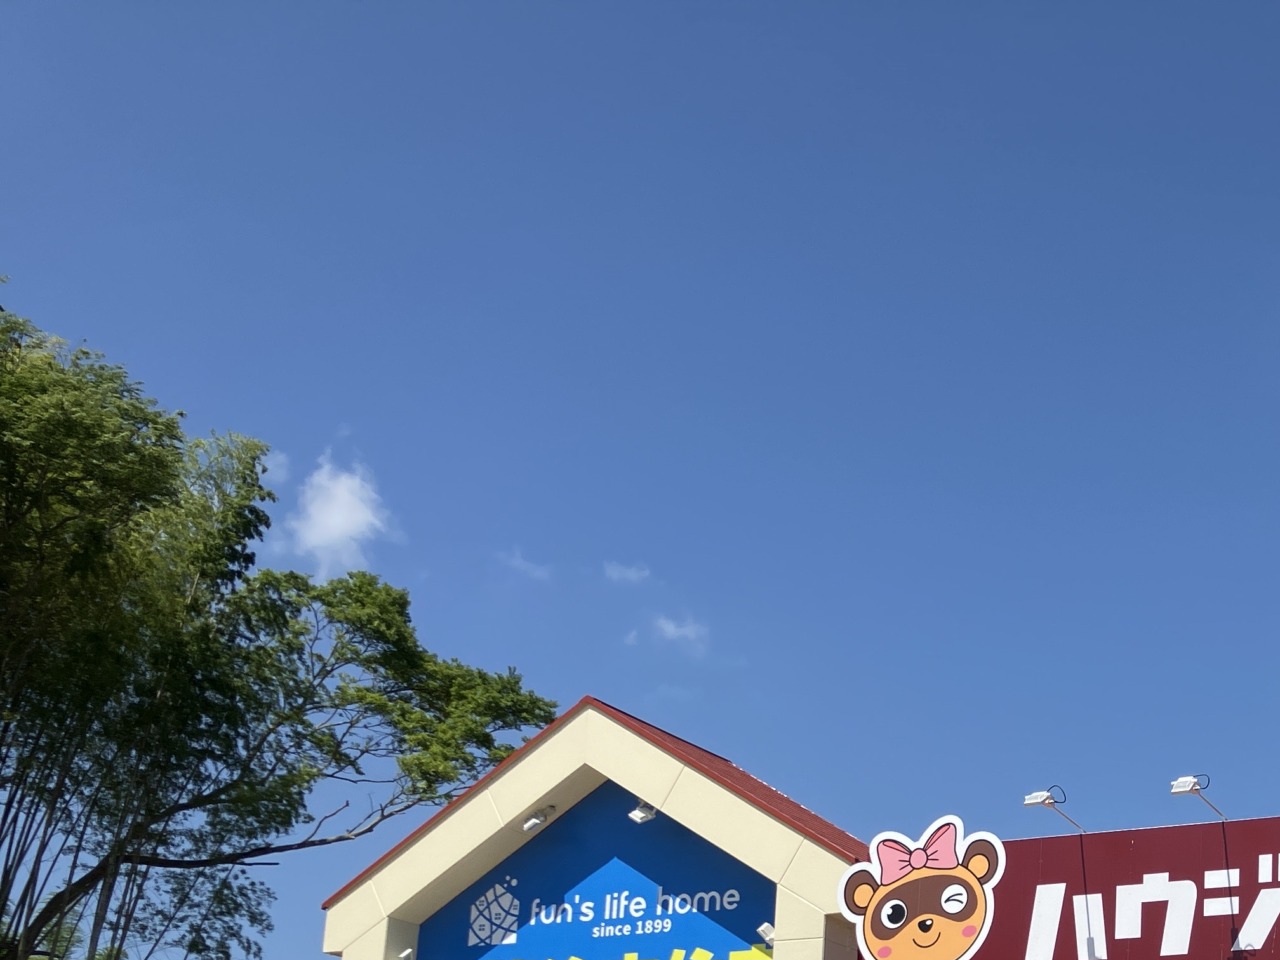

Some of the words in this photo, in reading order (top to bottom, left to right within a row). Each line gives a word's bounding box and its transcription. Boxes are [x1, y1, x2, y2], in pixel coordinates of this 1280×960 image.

[530, 895, 595, 925] fun's
[605, 891, 647, 919] life
[657, 886, 740, 917] home
[591, 922, 632, 937] since
[634, 918, 672, 936] 1899
